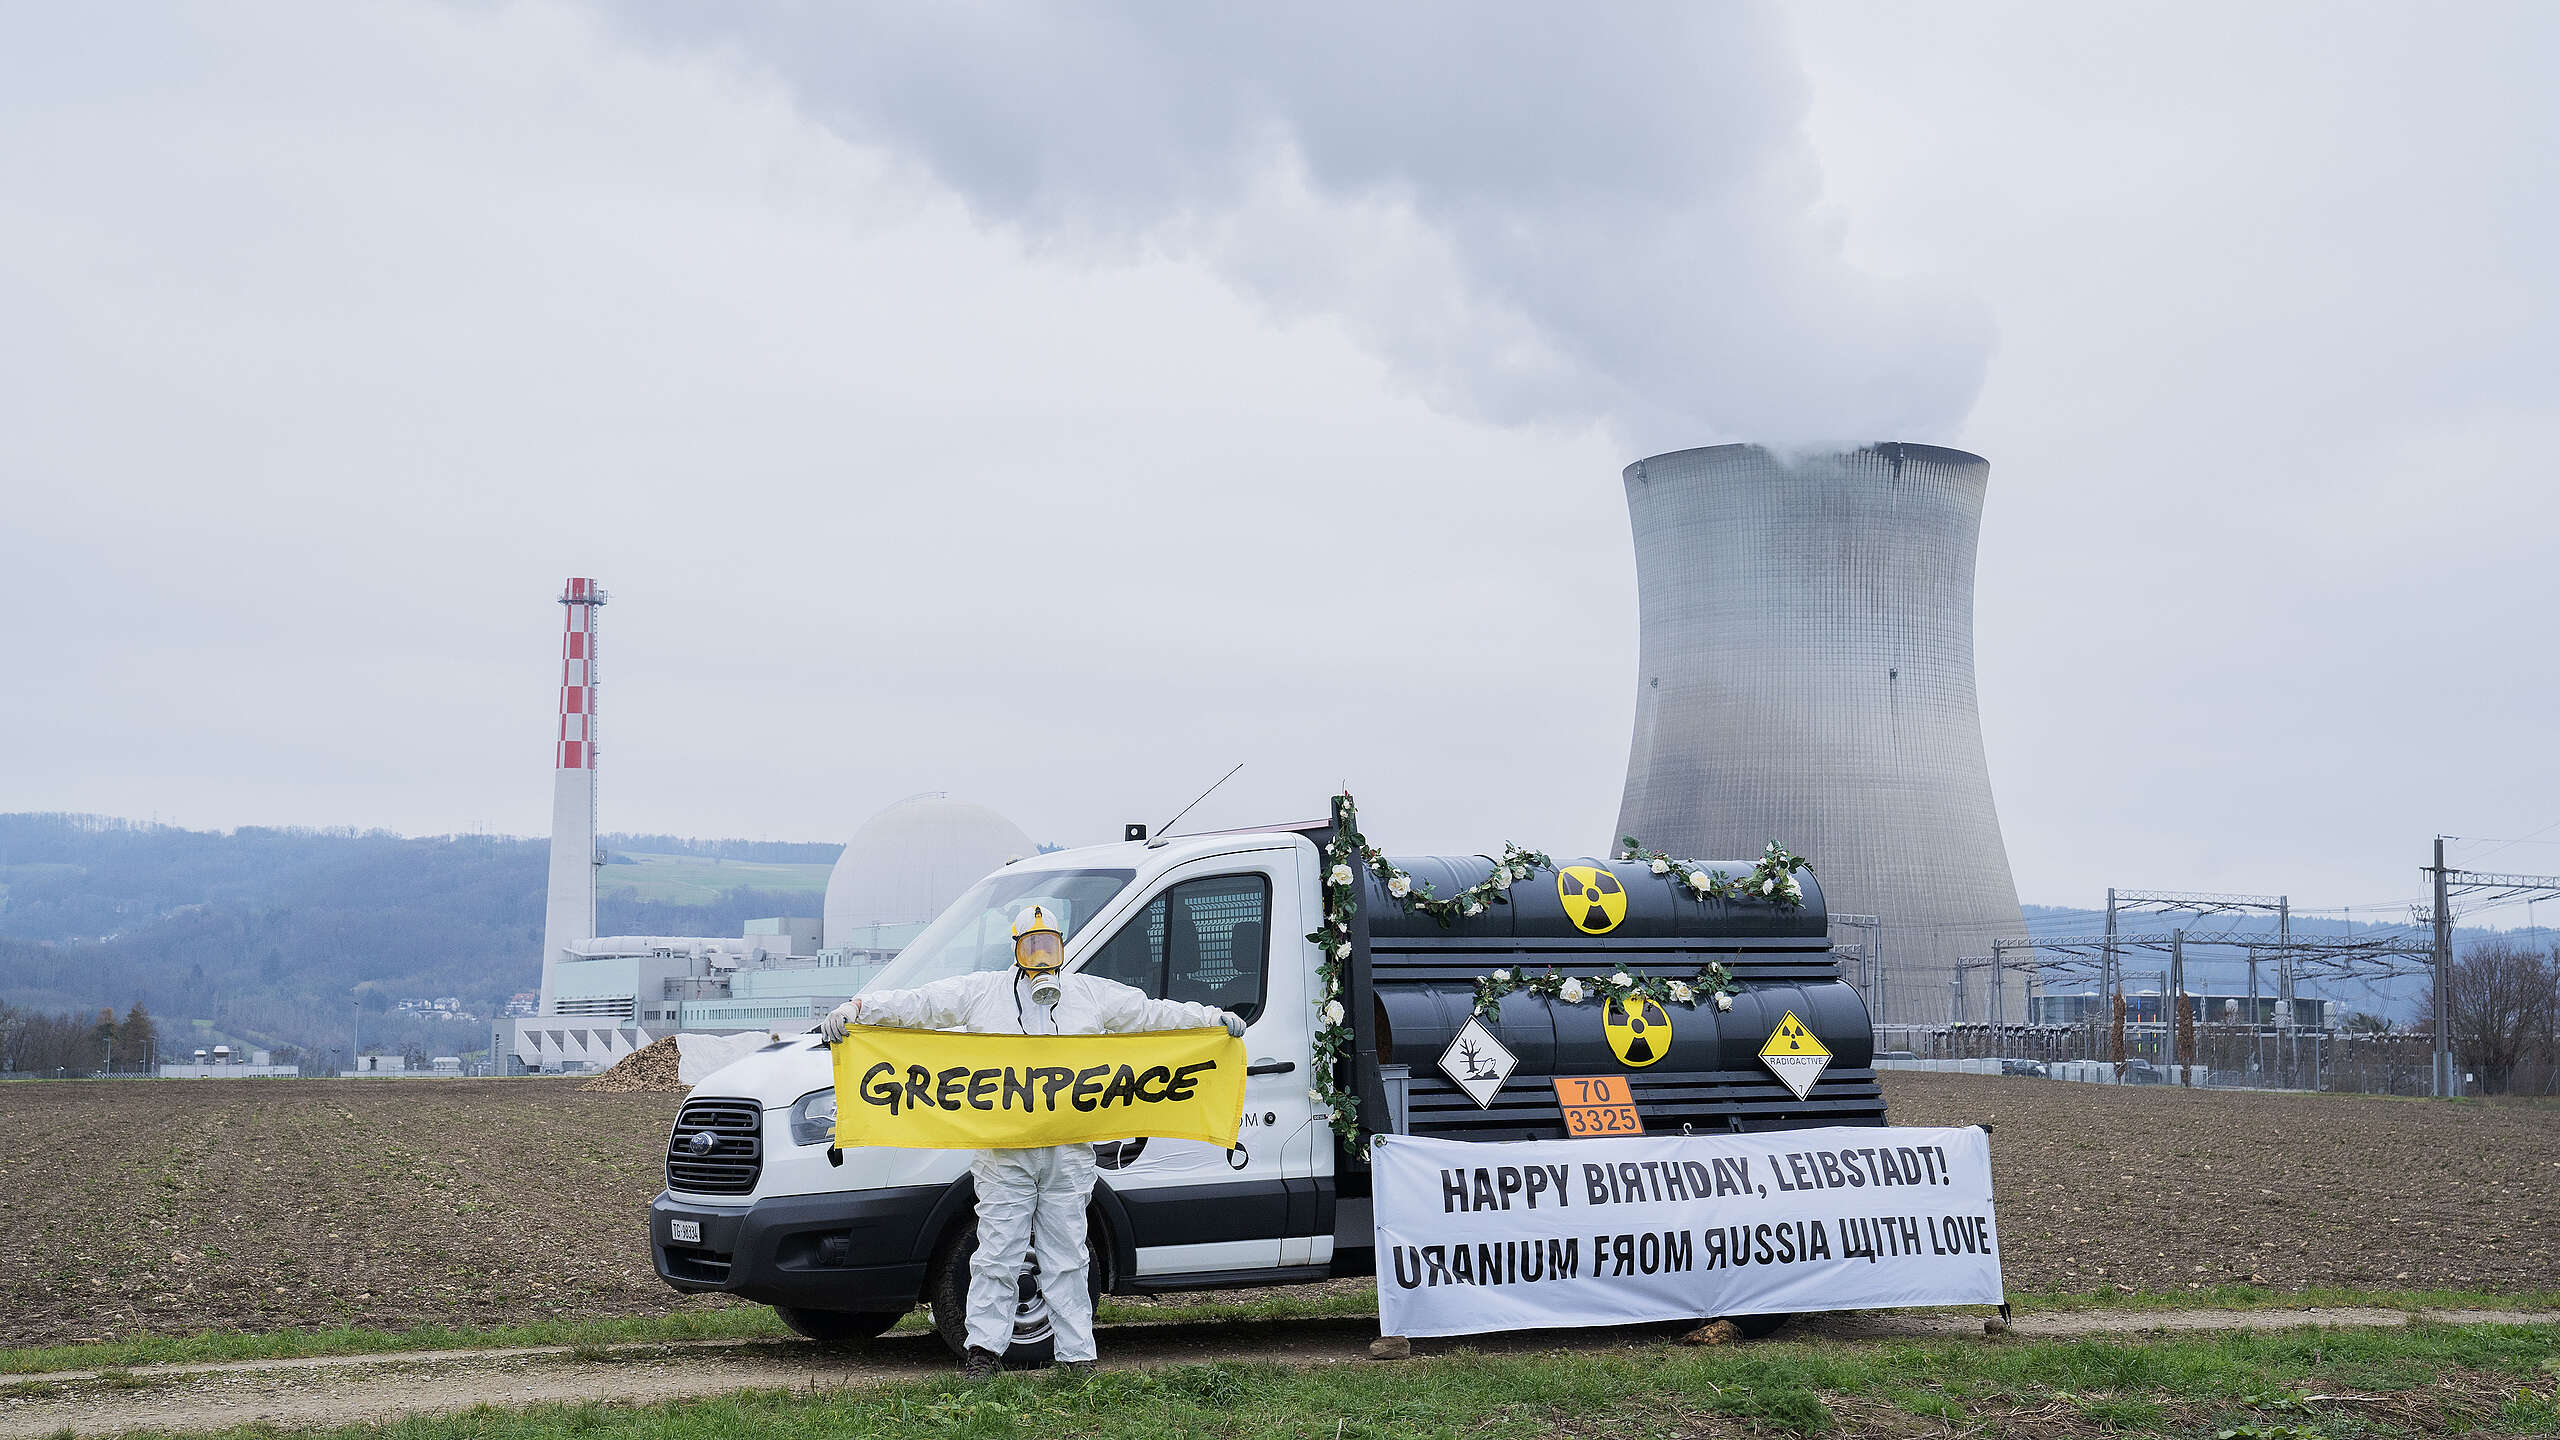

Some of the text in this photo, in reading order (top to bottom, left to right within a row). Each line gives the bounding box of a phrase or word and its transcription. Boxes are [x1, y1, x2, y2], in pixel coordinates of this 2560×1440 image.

[1770, 1057, 1824, 1066] RADIOACTIVE
[859, 1060, 1217, 1116] GREENPEACE
[1574, 1080, 1610, 1102] 70
[1798, 1084, 1804, 1094] 7
[1569, 1109, 1636, 1132] 3325
[1440, 1164, 1569, 1214] HAPPY
[1767, 1146, 1950, 1192] LEIBSTADT!
[1926, 1215, 1992, 1256] LOVE
